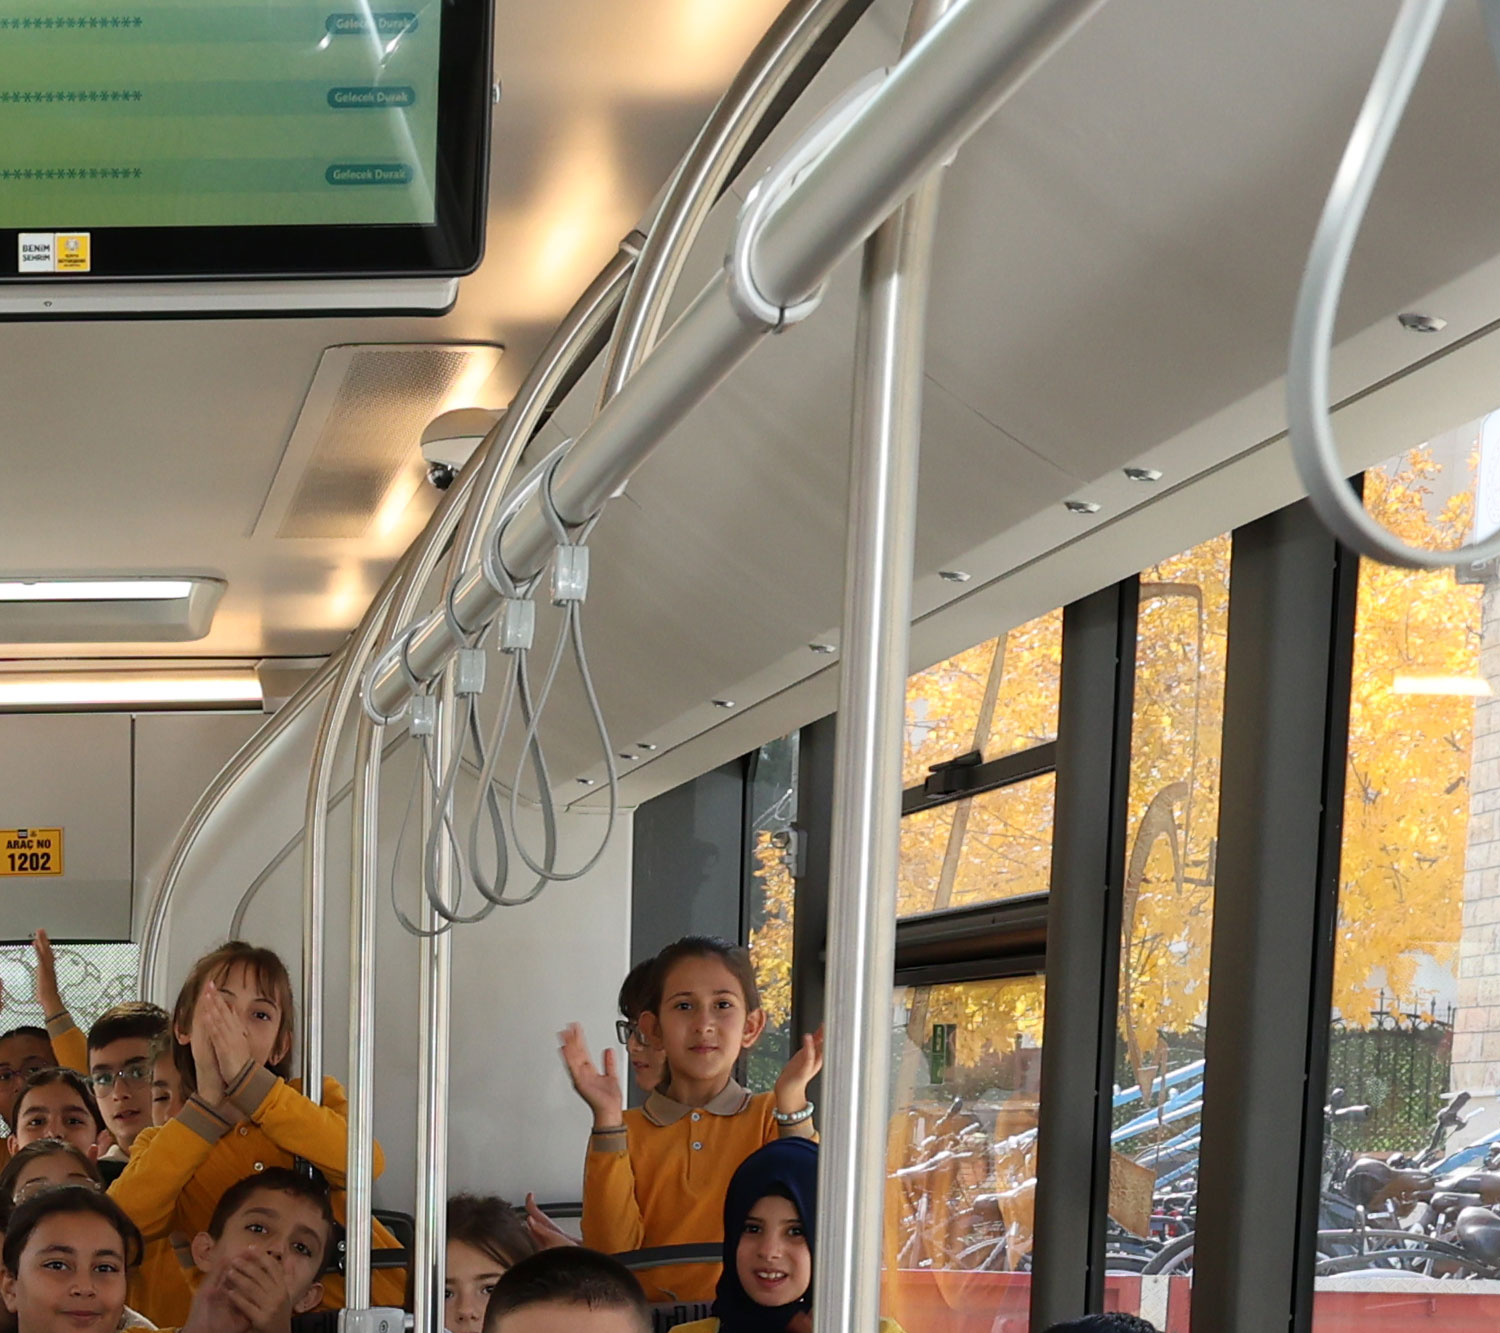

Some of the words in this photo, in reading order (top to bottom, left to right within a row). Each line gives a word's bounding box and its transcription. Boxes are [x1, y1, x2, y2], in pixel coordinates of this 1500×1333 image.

[335, 92, 374, 103] Gelecek
[377, 92, 408, 103] Durak
[333, 169, 372, 180] Gelecek
[375, 169, 405, 180] Durak
[6, 839, 33, 850] ARAÇ
[36, 839, 51, 849] NO
[7, 852, 51, 871] 1202
